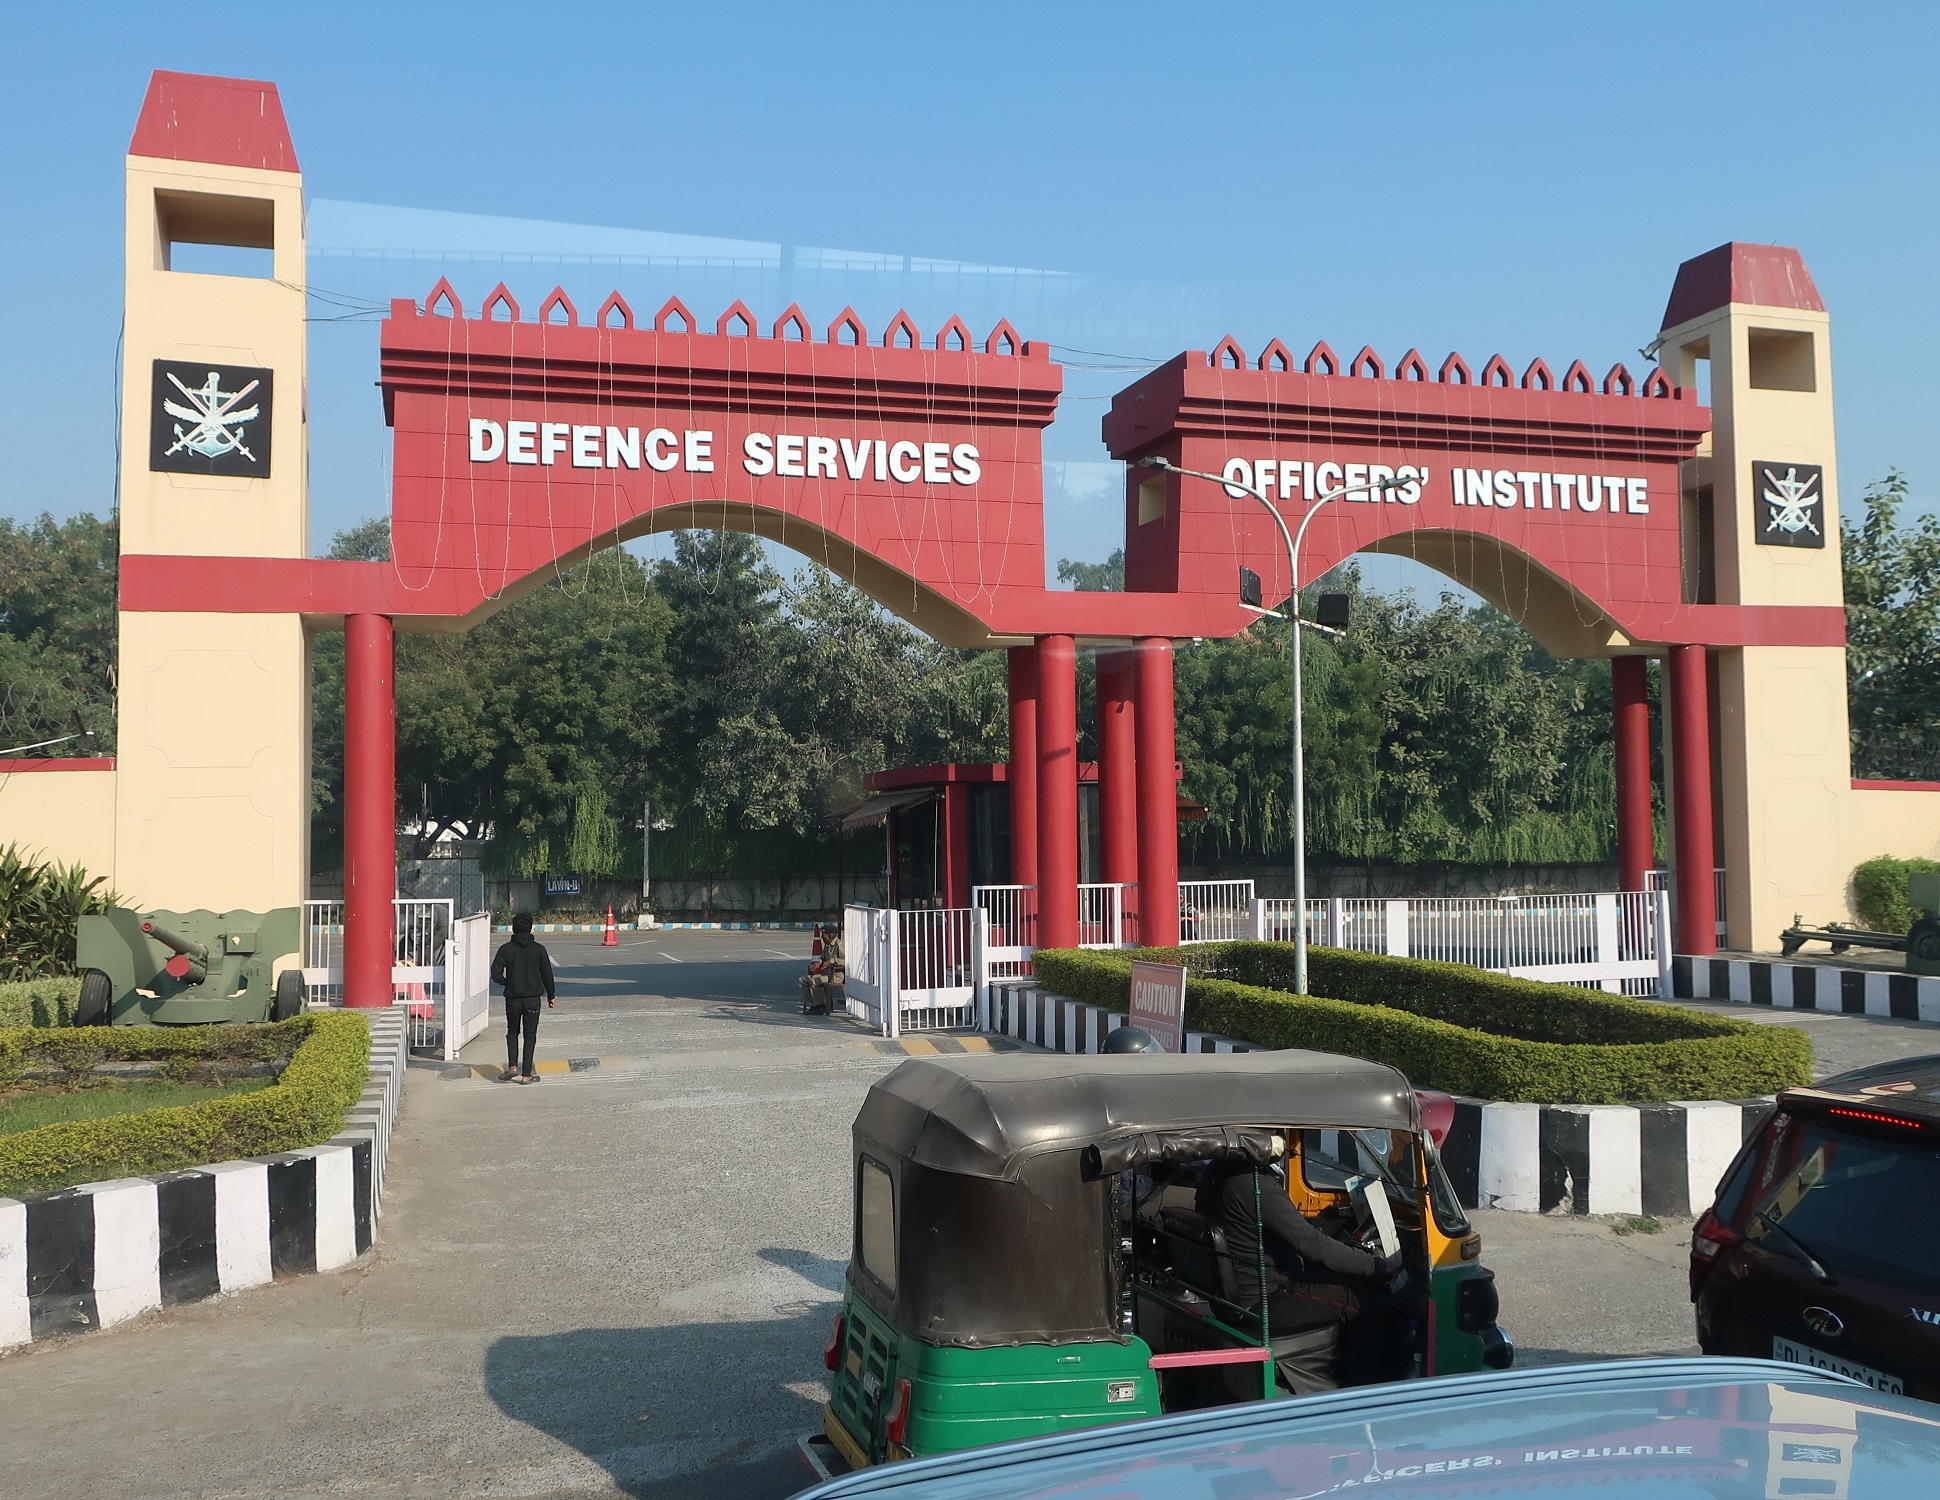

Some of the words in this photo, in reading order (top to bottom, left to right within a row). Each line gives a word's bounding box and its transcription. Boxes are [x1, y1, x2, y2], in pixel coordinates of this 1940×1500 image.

[468, 417, 716, 473] DEFENCE
[742, 431, 982, 486] SERVICES
[1221, 456, 1430, 505] OFFICERS'
[1452, 467, 1650, 515] INSTITUTE
[1135, 980, 1176, 1016] CAUTION
